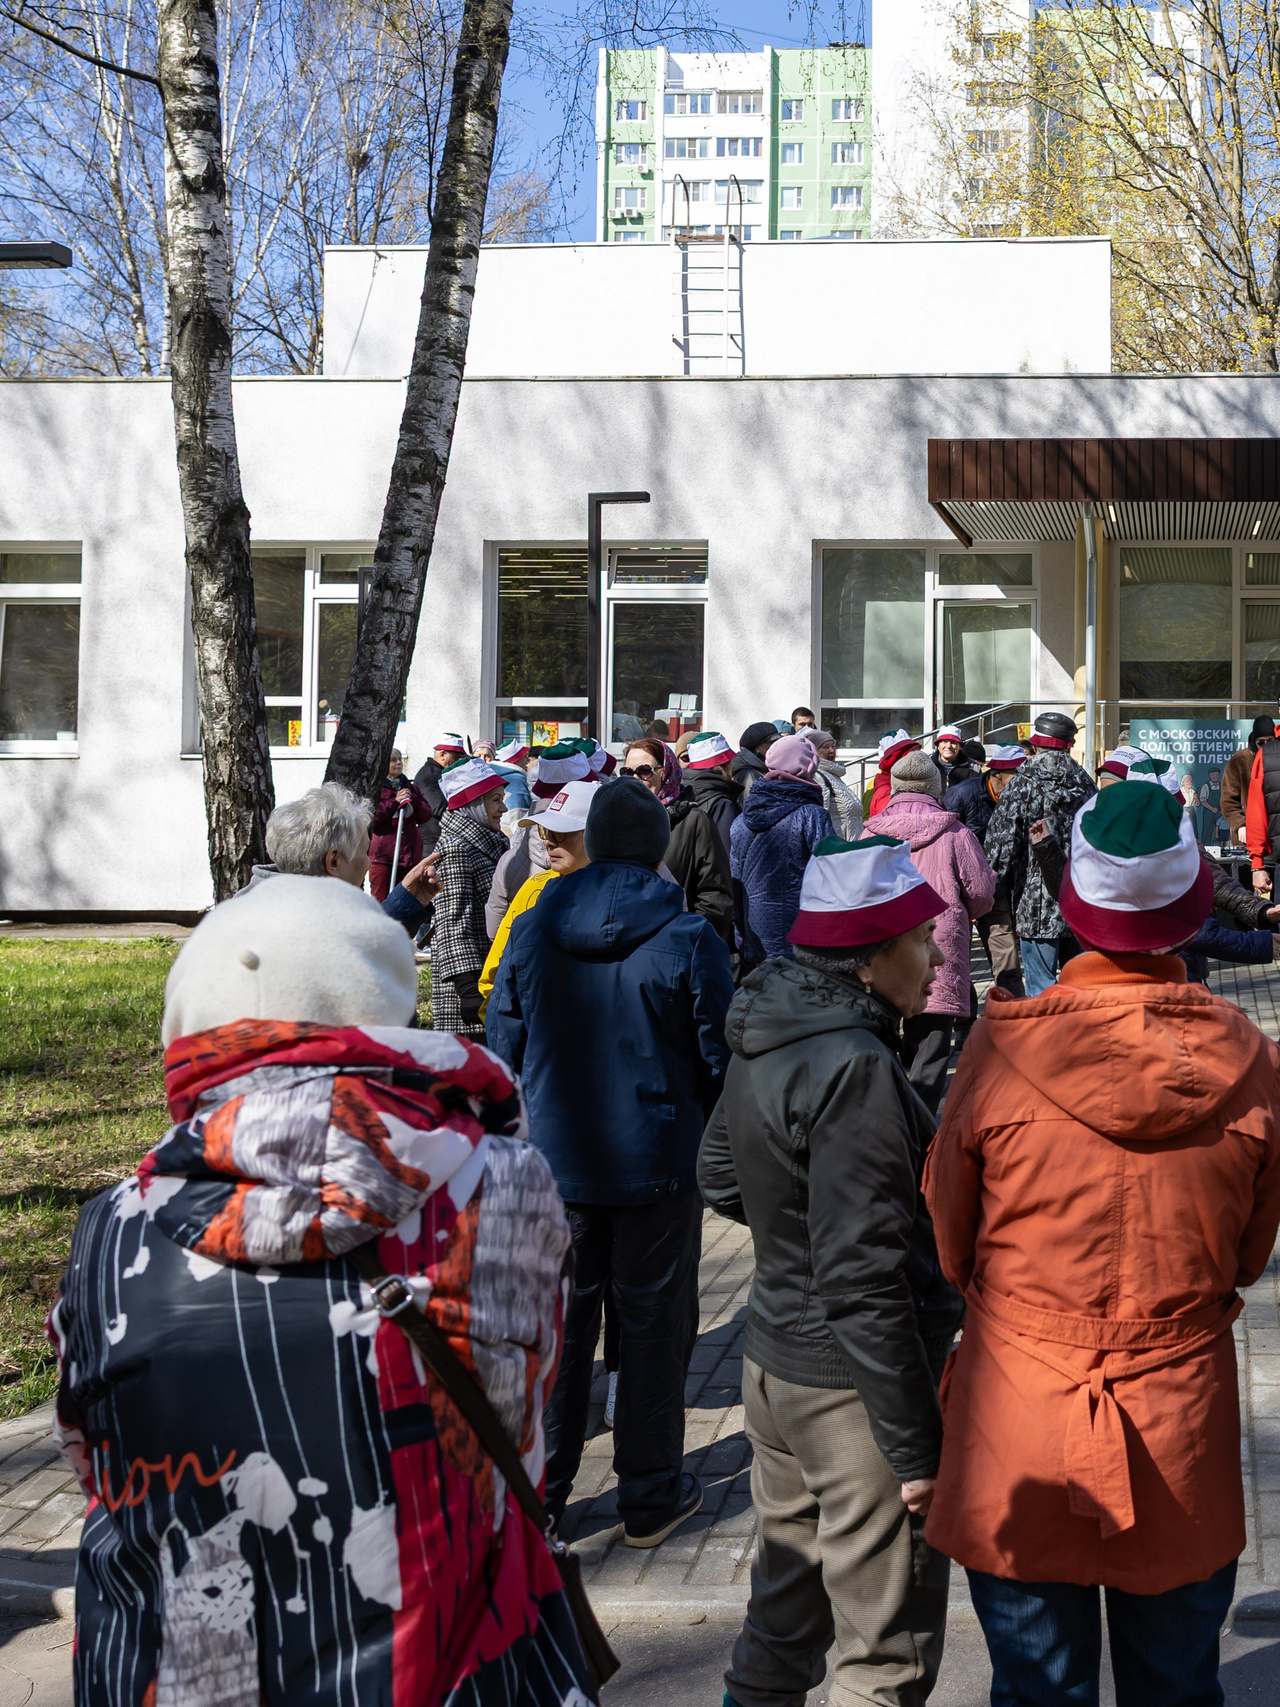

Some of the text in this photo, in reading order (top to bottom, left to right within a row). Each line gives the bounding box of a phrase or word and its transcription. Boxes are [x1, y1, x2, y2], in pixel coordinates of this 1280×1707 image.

[1138, 729, 1241, 740] С МОСКОВСКИМ
[1140, 741, 1234, 752] ДОЛГОЛЕТИЕМ
[1176, 753, 1196, 764] ПО
[1198, 753, 1234, 764] ПЛЕЧ
